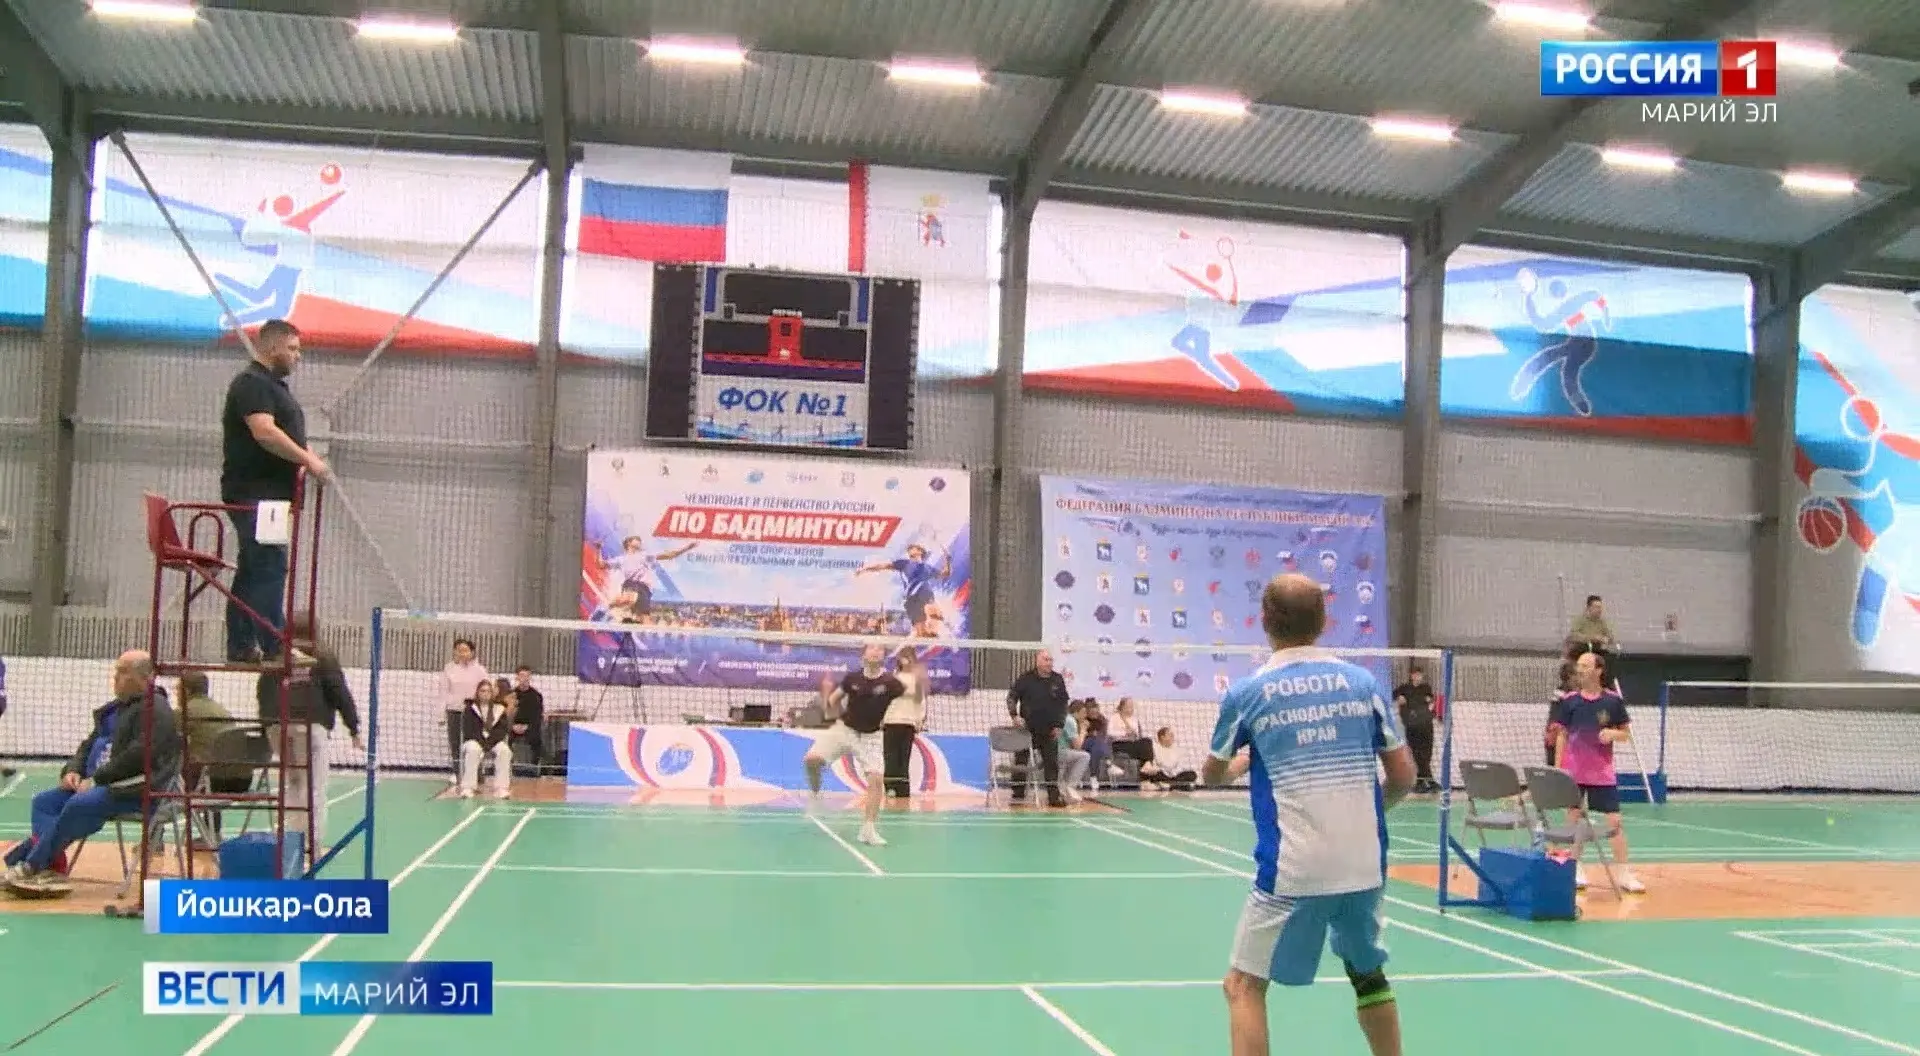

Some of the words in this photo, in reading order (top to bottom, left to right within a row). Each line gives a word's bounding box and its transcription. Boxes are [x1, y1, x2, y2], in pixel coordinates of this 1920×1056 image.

[718, 387, 788, 413] ФОК
[796, 392, 848, 417] №1
[685, 493, 750, 508] ЧЕМПИОНАТ
[752, 497, 761, 507] И
[763, 498, 831, 511] ПЕРВЕНСТВО
[832, 500, 876, 513] РОССИИ
[669, 510, 707, 534] ПО
[711, 513, 888, 543] БАДМИНТОНУ
[1263, 673, 1350, 700] РОБОТА
